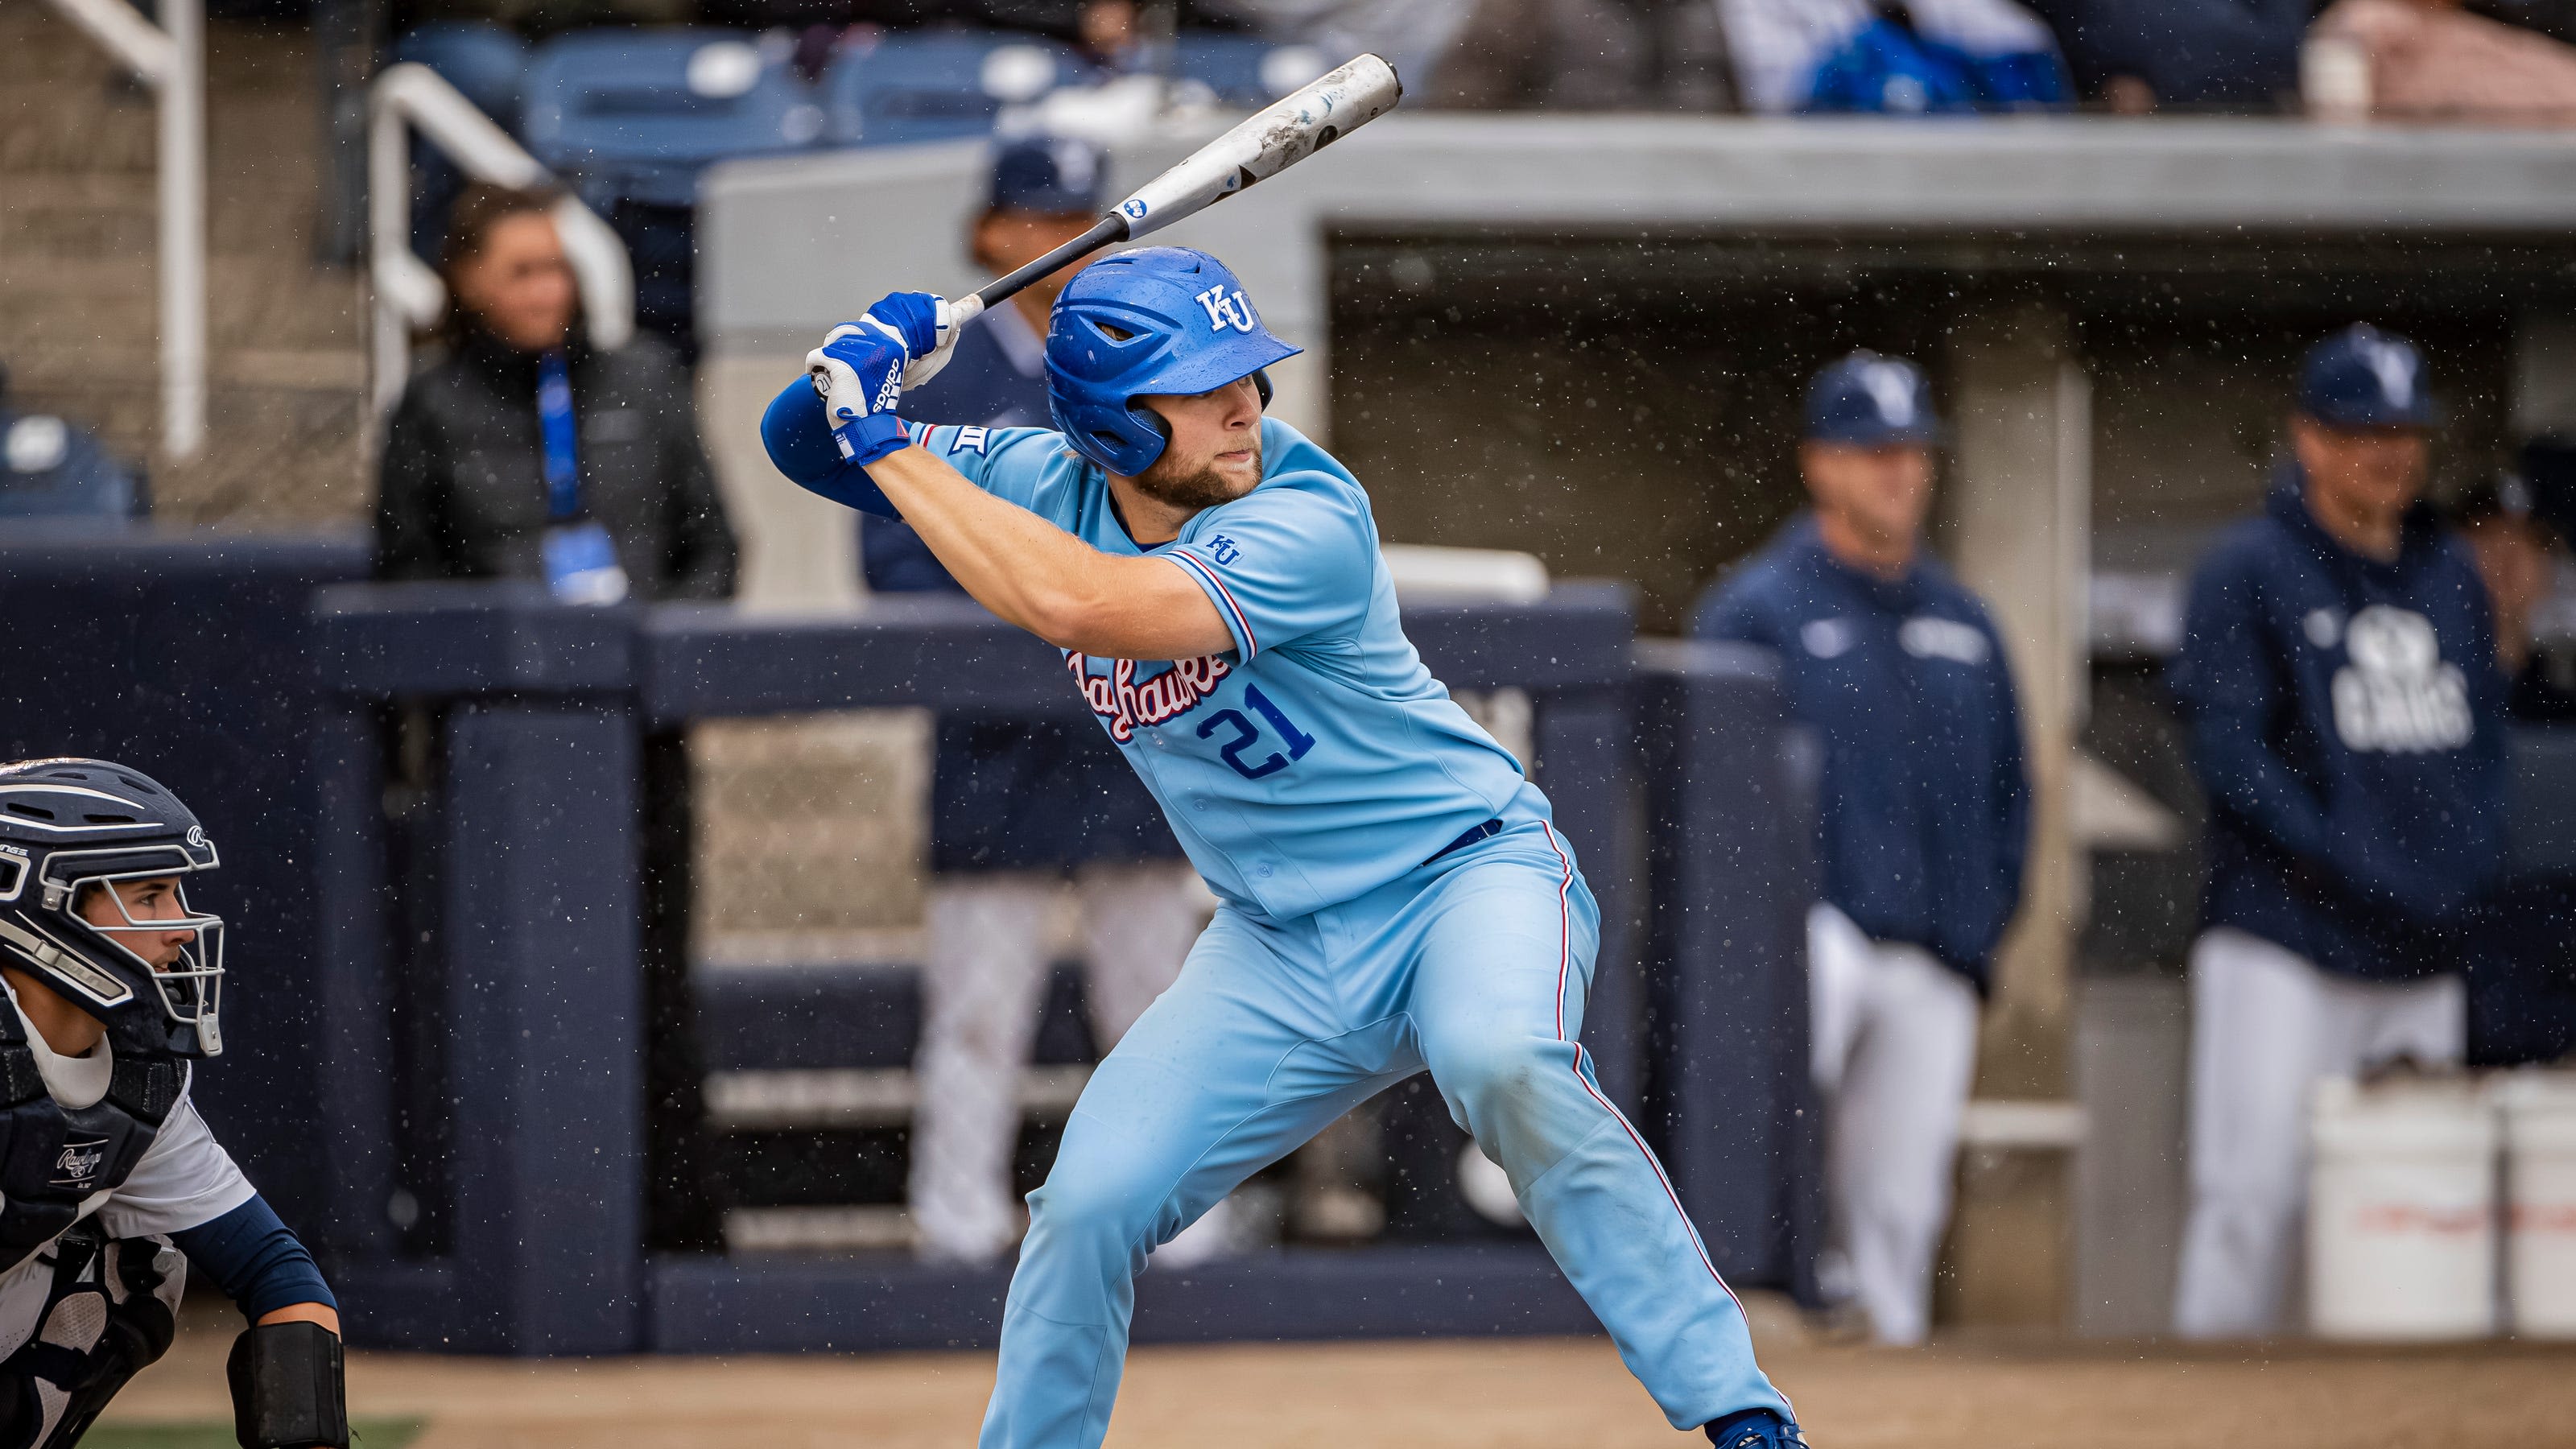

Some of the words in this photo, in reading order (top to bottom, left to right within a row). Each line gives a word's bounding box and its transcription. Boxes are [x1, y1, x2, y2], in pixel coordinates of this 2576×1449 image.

[1193, 283, 1254, 333] KU
[816, 376, 831, 393] 21
[873, 357, 899, 413] adidas
[1206, 534, 1240, 566] KU
[1196, 683, 1316, 779] 21
